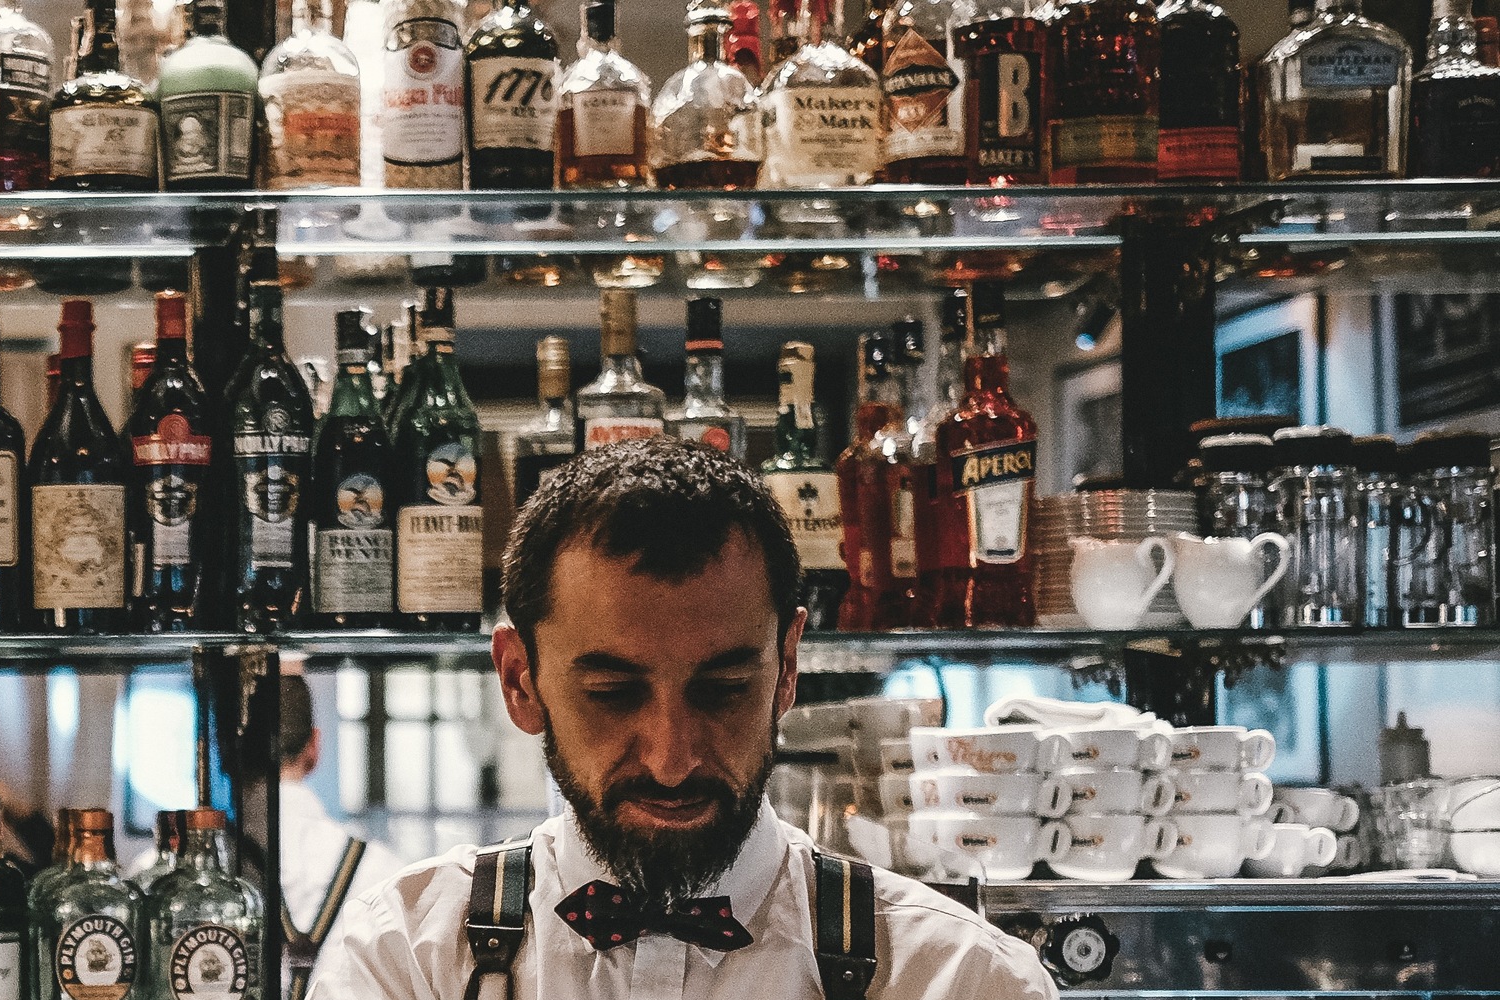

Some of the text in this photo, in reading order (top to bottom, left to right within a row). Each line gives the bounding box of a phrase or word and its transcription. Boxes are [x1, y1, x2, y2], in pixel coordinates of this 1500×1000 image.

[795, 97, 876, 110] Maker's
[820, 114, 872, 129] Mark
[962, 450, 1032, 486] APEROL
[61, 919, 135, 965] PLYMOUTH GIN
[174, 929, 247, 975] PLYMOUTH GIN
